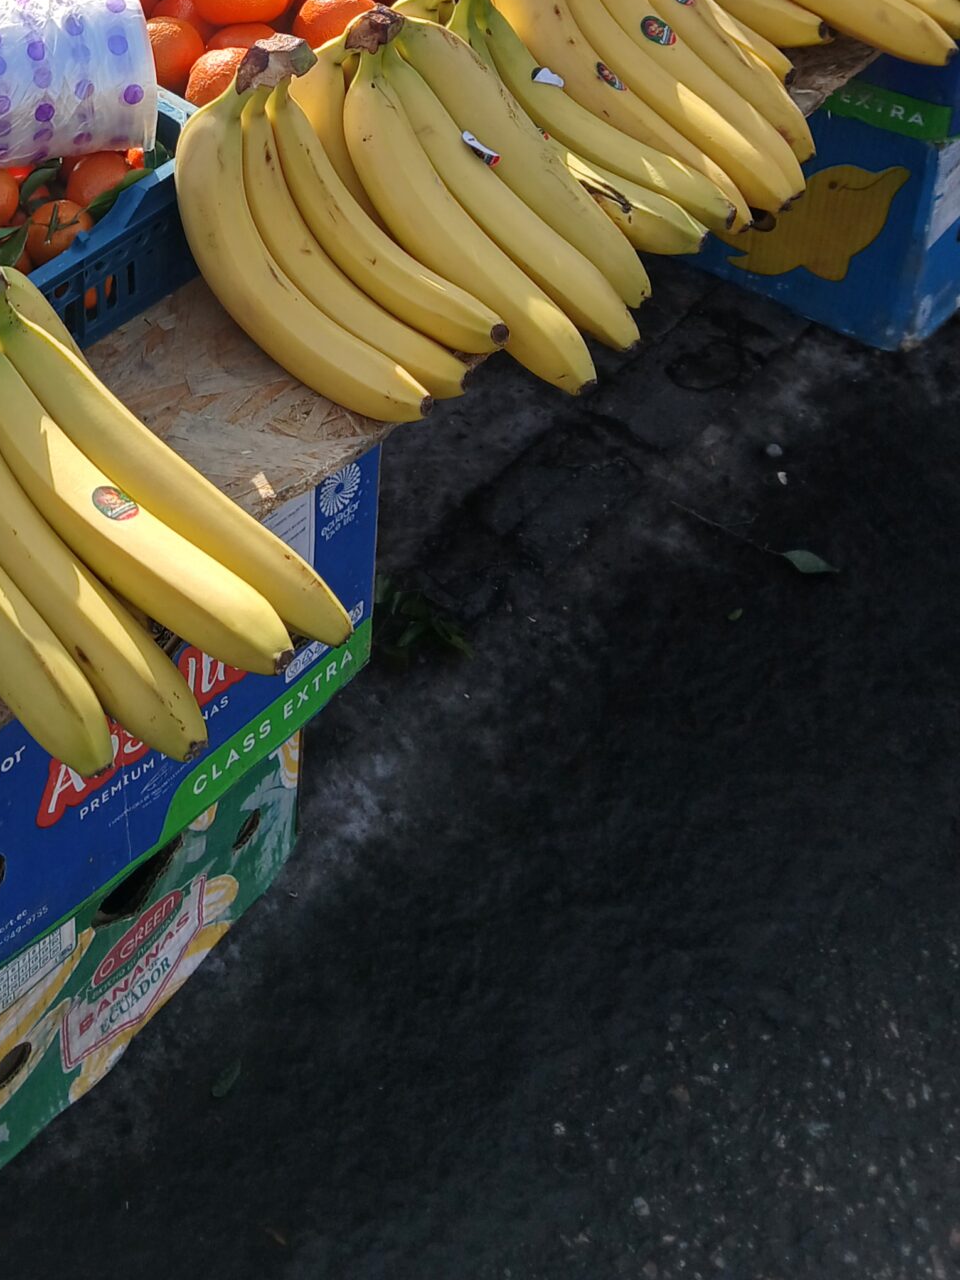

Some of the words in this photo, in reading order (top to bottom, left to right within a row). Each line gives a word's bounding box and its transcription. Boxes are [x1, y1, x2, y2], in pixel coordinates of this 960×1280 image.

[193, 720, 272, 796] CLASS
[283, 649, 353, 720] EXTRA
[79, 760, 155, 821] PREMIUM
[79, 911, 190, 1037] BANANAS
[99, 957, 172, 1035] ECUADOR
